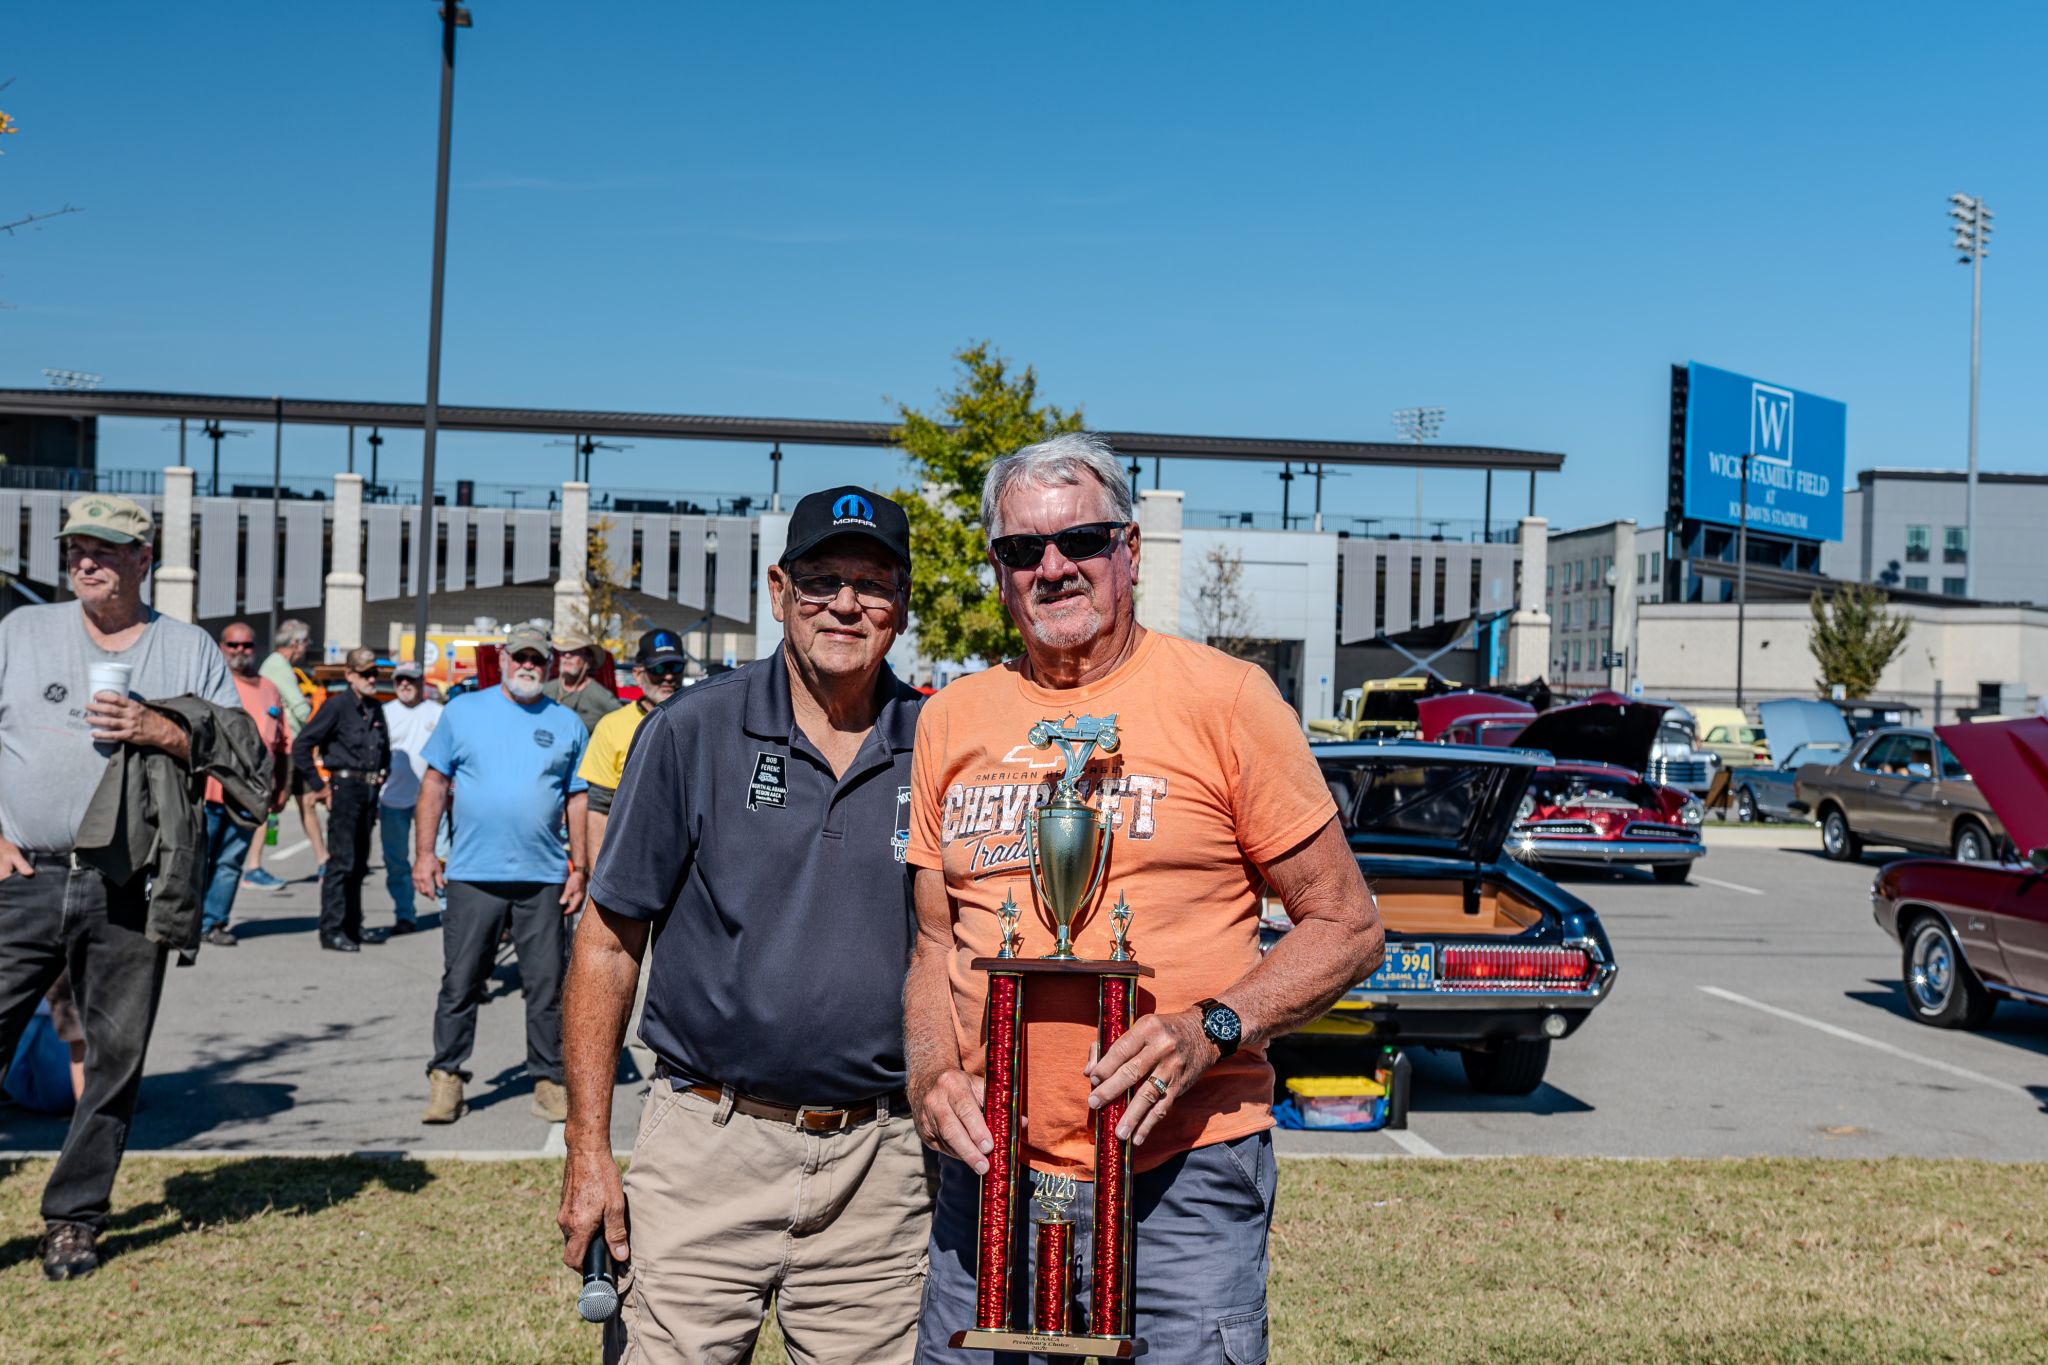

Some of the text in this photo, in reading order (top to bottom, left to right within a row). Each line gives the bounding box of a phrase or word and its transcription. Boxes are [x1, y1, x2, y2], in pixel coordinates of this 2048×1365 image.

[1757, 395, 1789, 452] W
[1708, 451, 1830, 497] WICK FAMILY FIELD
[833, 518, 873, 527] MOPAR
[760, 763, 780, 773] FERENC
[766, 756, 778, 764] BOB
[975, 766, 1120, 782] AMERICAN HEAGE
[941, 774, 1168, 849] CHEVRET
[1401, 953, 1431, 972] 994
[1375, 972, 1413, 981] ALABAMA
[1034, 1170, 1076, 1199] 2026
